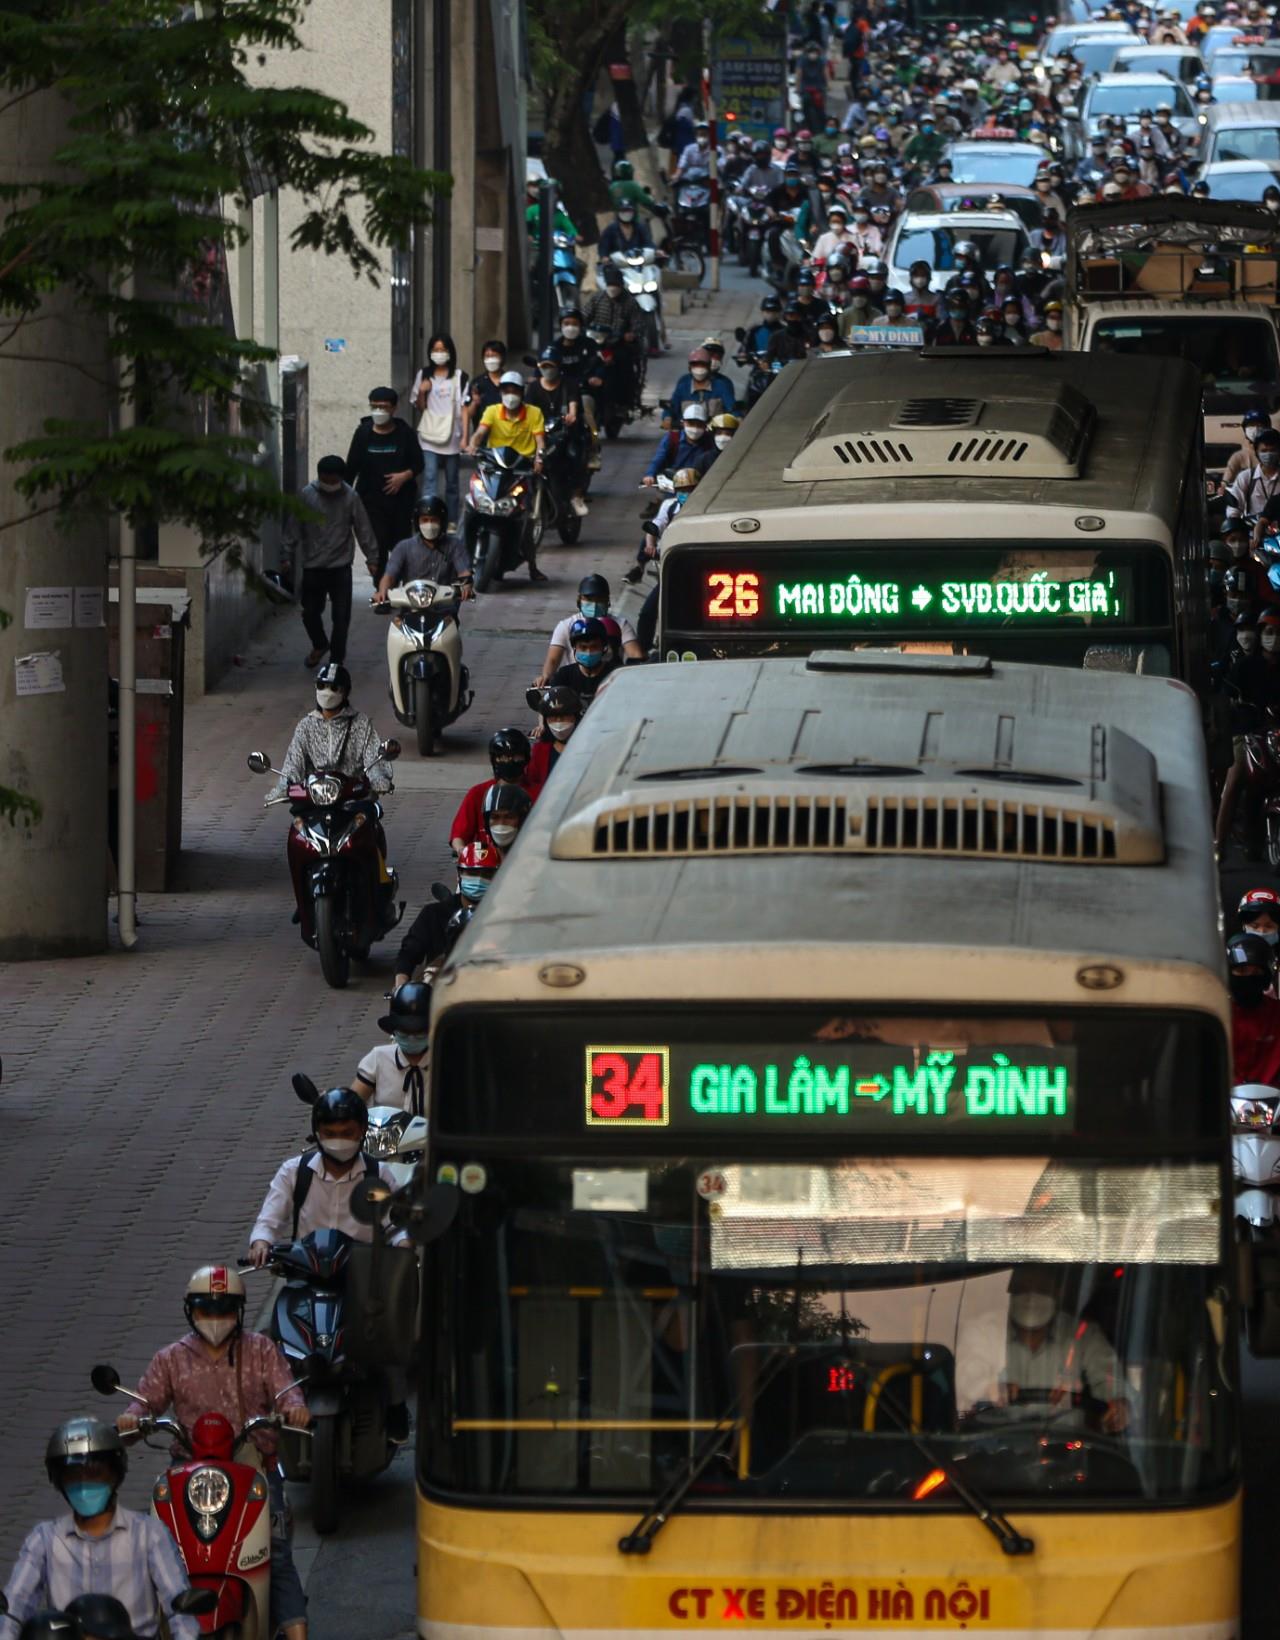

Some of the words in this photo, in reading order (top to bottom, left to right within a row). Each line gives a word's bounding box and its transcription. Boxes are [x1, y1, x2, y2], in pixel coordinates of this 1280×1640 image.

[708, 573, 759, 617] 26
[778, 583, 825, 614] MAI
[591, 1053, 662, 1120] 34
[690, 1063, 757, 1114] GIA
[764, 1054, 850, 1114] LÂM
[892, 1050, 957, 1115] MỸ
[964, 1052, 1068, 1116] ĐÌNH
[668, 1588, 714, 1620] CT
[722, 1588, 765, 1620] XE
[776, 1580, 858, 1629] ĐIỆN
[868, 1580, 914, 1621] HÀ
[924, 1580, 990, 1629] NỘI
